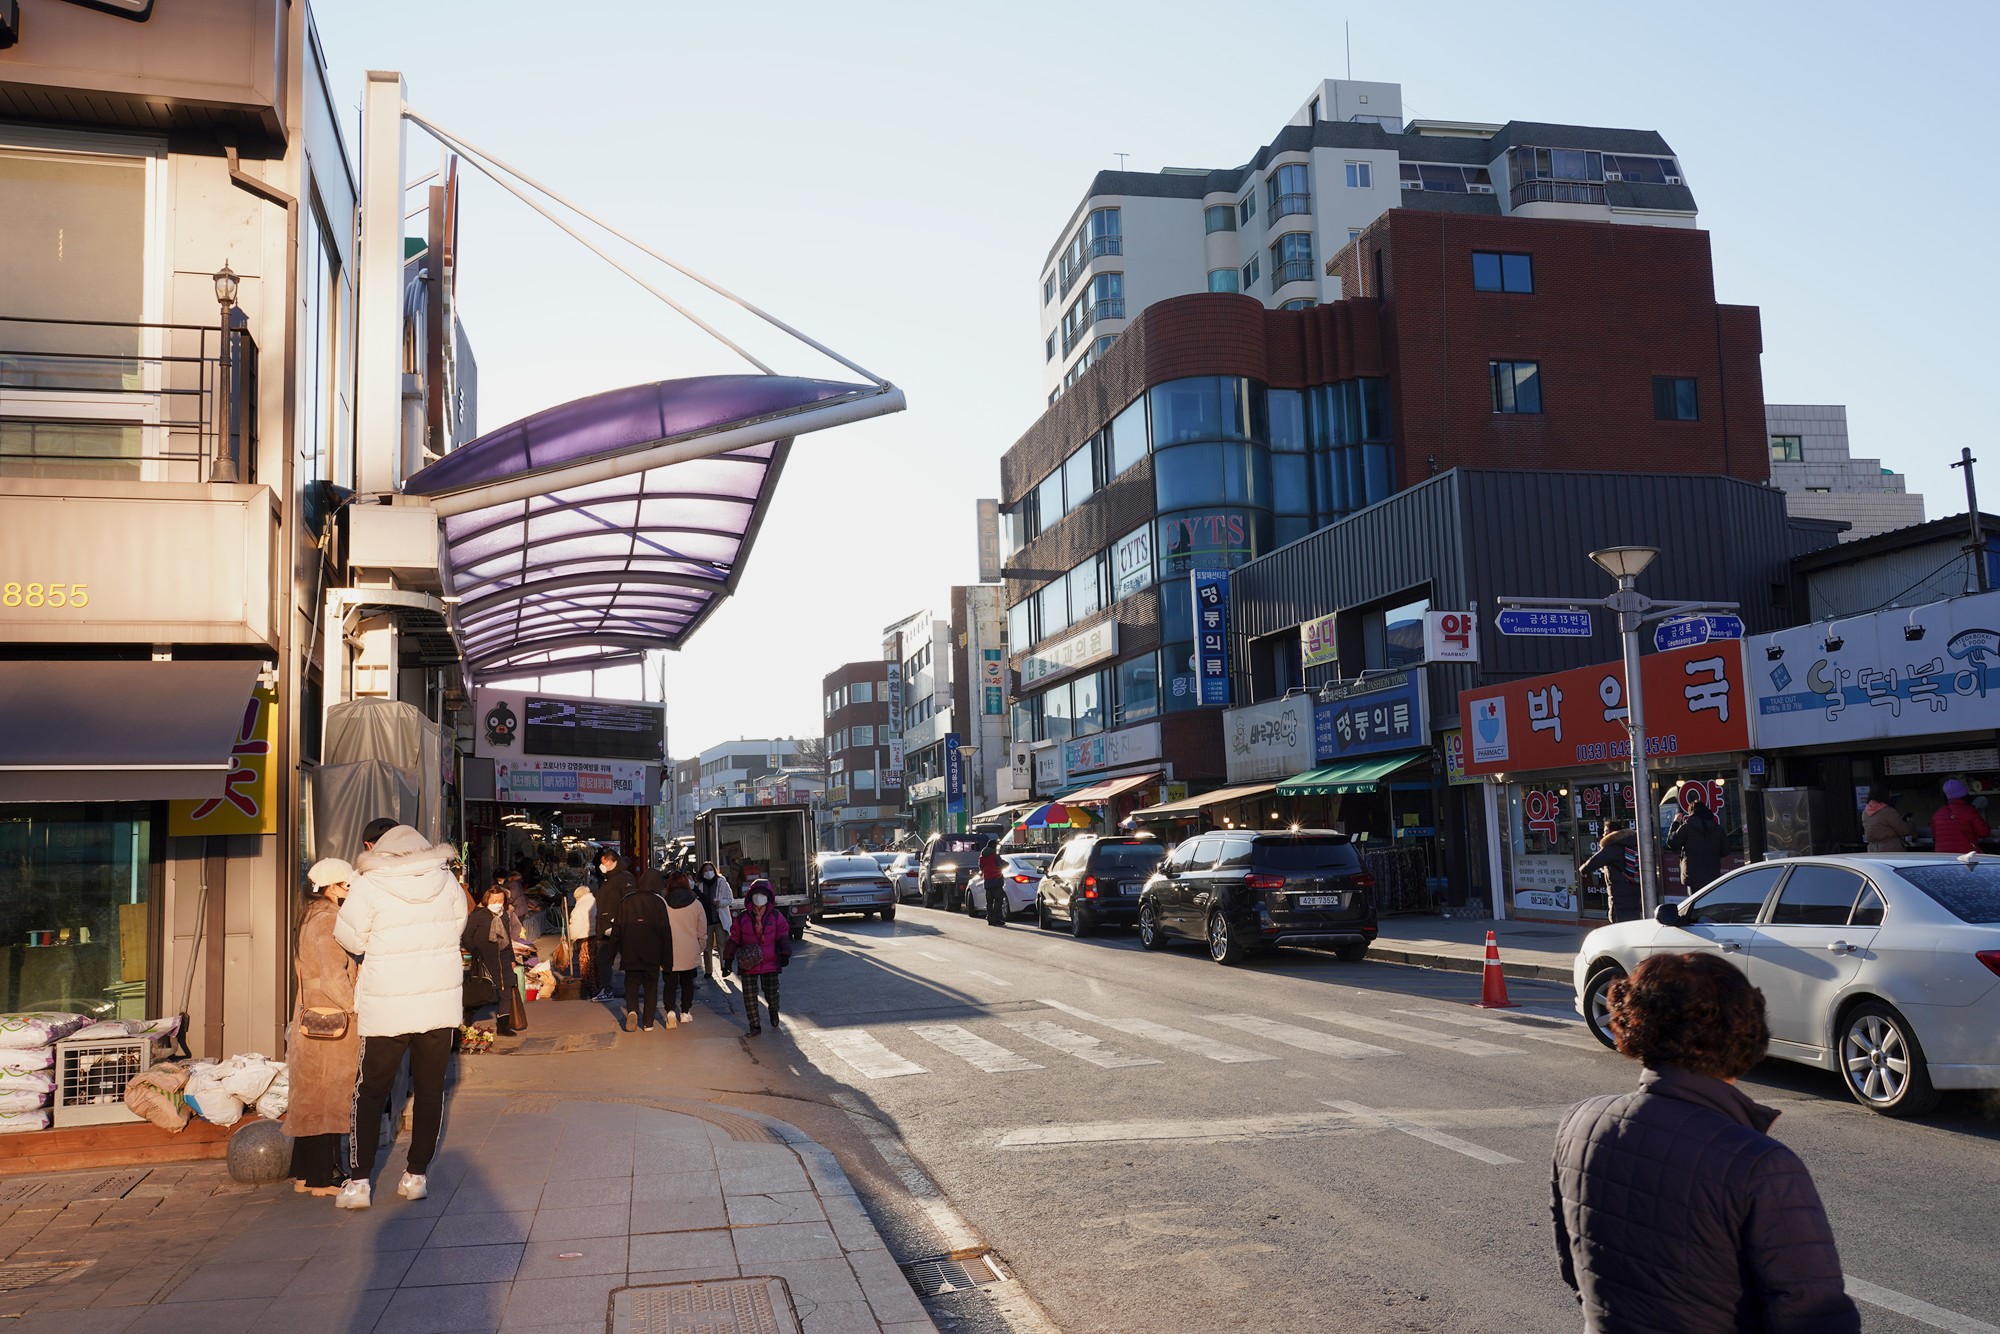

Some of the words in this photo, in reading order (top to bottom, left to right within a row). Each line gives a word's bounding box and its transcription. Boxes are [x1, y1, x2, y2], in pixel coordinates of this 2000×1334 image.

[1167, 514, 1245, 549] CYTS
[1120, 532, 1148, 573] CYTS
[2, 582, 90, 609] 8855
[1200, 586, 1222, 676] 명동의류
[1441, 614, 1472, 650] 약
[1513, 626, 1556, 634] Geumseong-ro
[1558, 626, 1589, 635] 13beon-gil
[1671, 623, 1692, 638] 금성로
[1700, 626, 1706, 635] 12
[1667, 636, 1698, 647] Geumseong-ro
[1039, 630, 1102, 677] 홍내과의원
[1367, 677, 1390, 692] FASHION
[1391, 673, 1409, 687] TOWN
[1785, 695, 1797, 704] OUT
[1336, 703, 1410, 742] 명동의류
[1477, 747, 1505, 757] PHARMACY
[1577, 743, 1607, 762] (033)
[543, 762, 566, 770] 코로나19
[1752, 765, 1762, 773] 14
[1583, 786, 1602, 817] 약
[1525, 790, 1560, 845] 약
